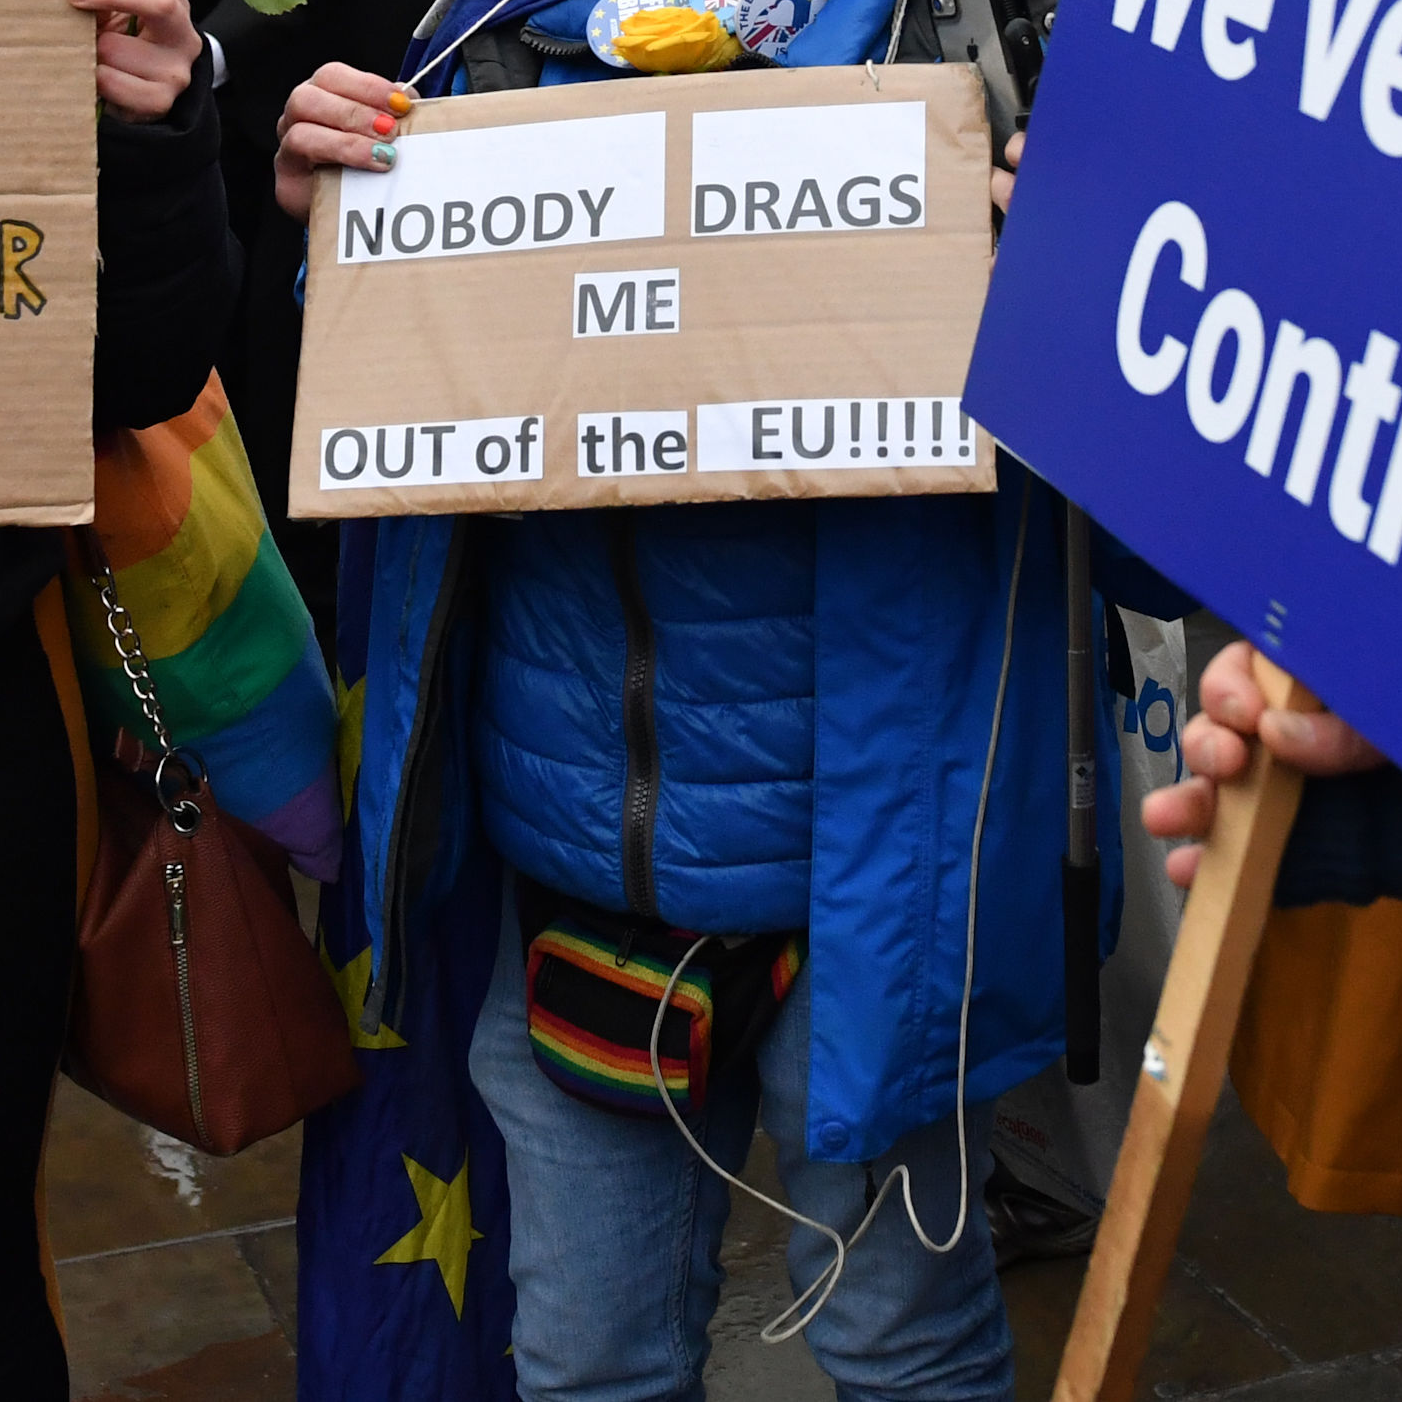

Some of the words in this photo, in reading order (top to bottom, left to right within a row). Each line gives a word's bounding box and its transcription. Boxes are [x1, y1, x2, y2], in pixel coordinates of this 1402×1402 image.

[740, 5, 750, 30] THE
[345, 186, 615, 258] NOBODY
[694, 174, 923, 234] DRAGS
[576, 279, 677, 335] ME
[324, 424, 457, 481] OUT
[474, 418, 540, 475] of
[581, 417, 688, 474] the
[752, 400, 970, 460] EU!!!!!
